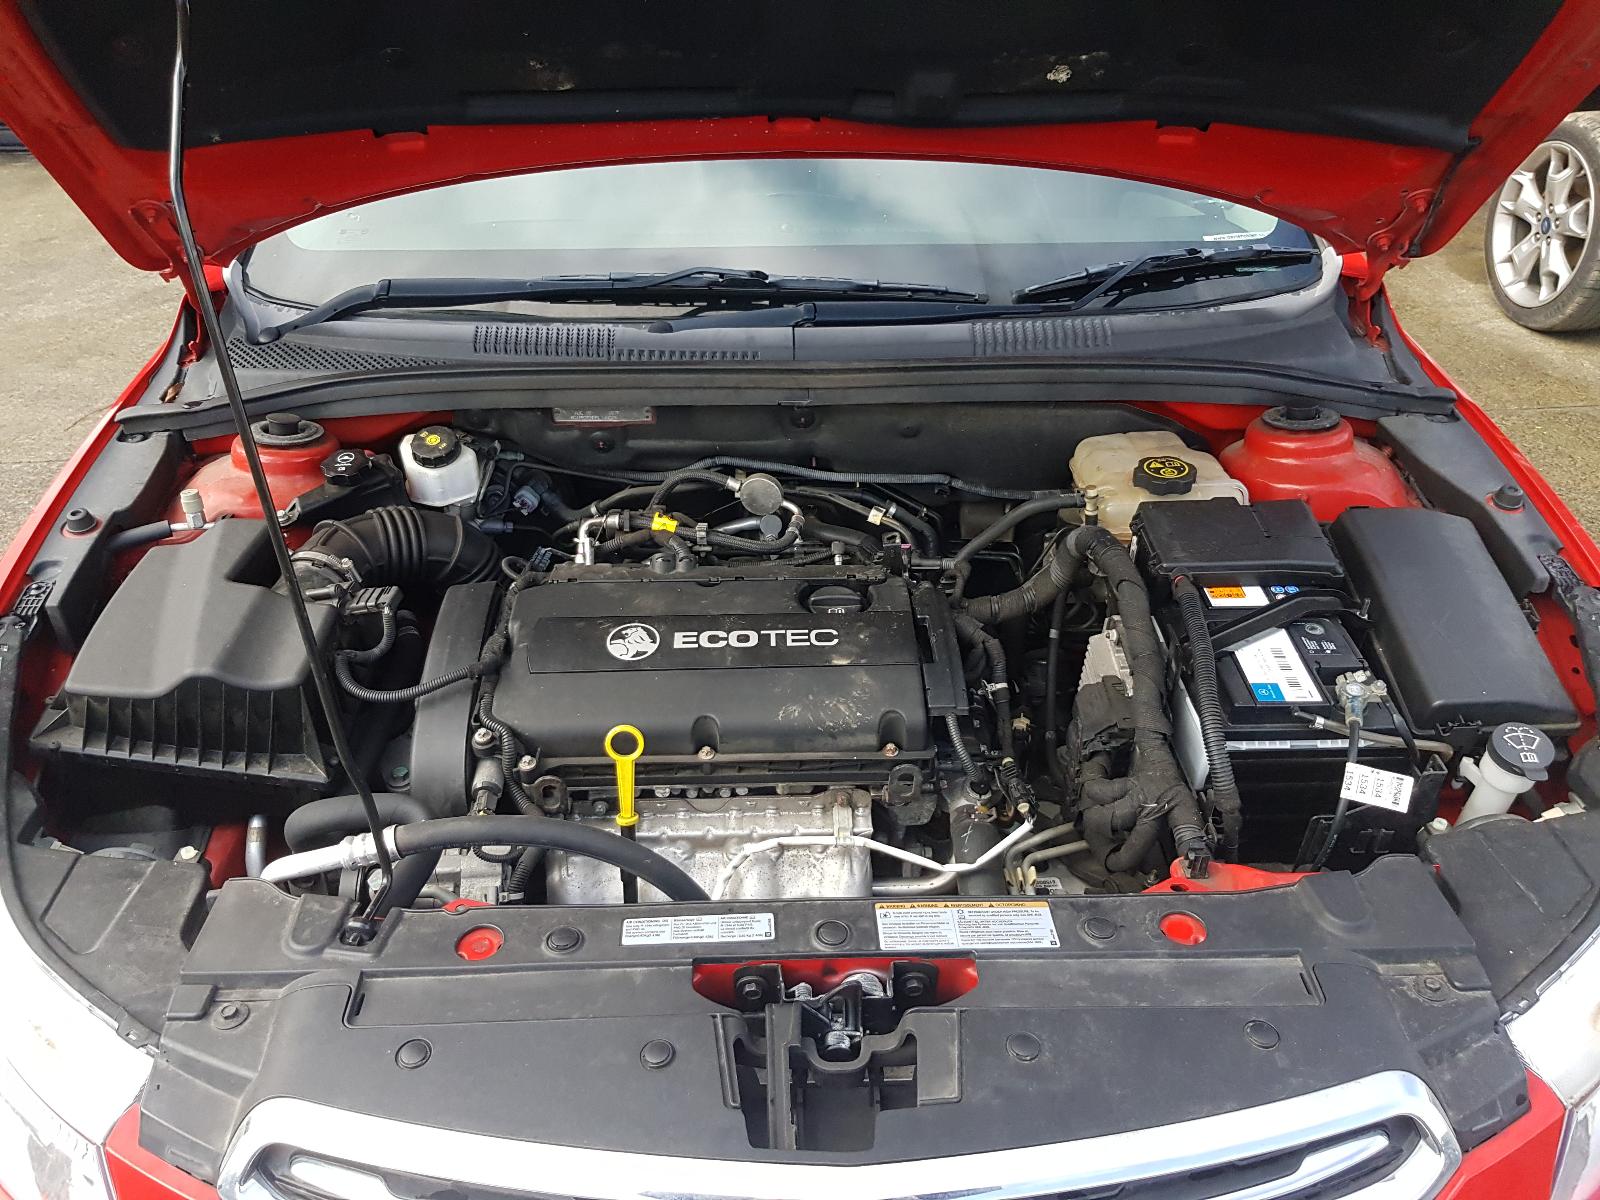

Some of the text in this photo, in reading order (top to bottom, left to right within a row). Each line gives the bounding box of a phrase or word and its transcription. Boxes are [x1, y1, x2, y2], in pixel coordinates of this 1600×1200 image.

[673, 629, 839, 648] ECOTEC
[1344, 770, 1354, 791] 1534
[1359, 774, 1369, 795] 1534
[1375, 778, 1385, 798] 1534
